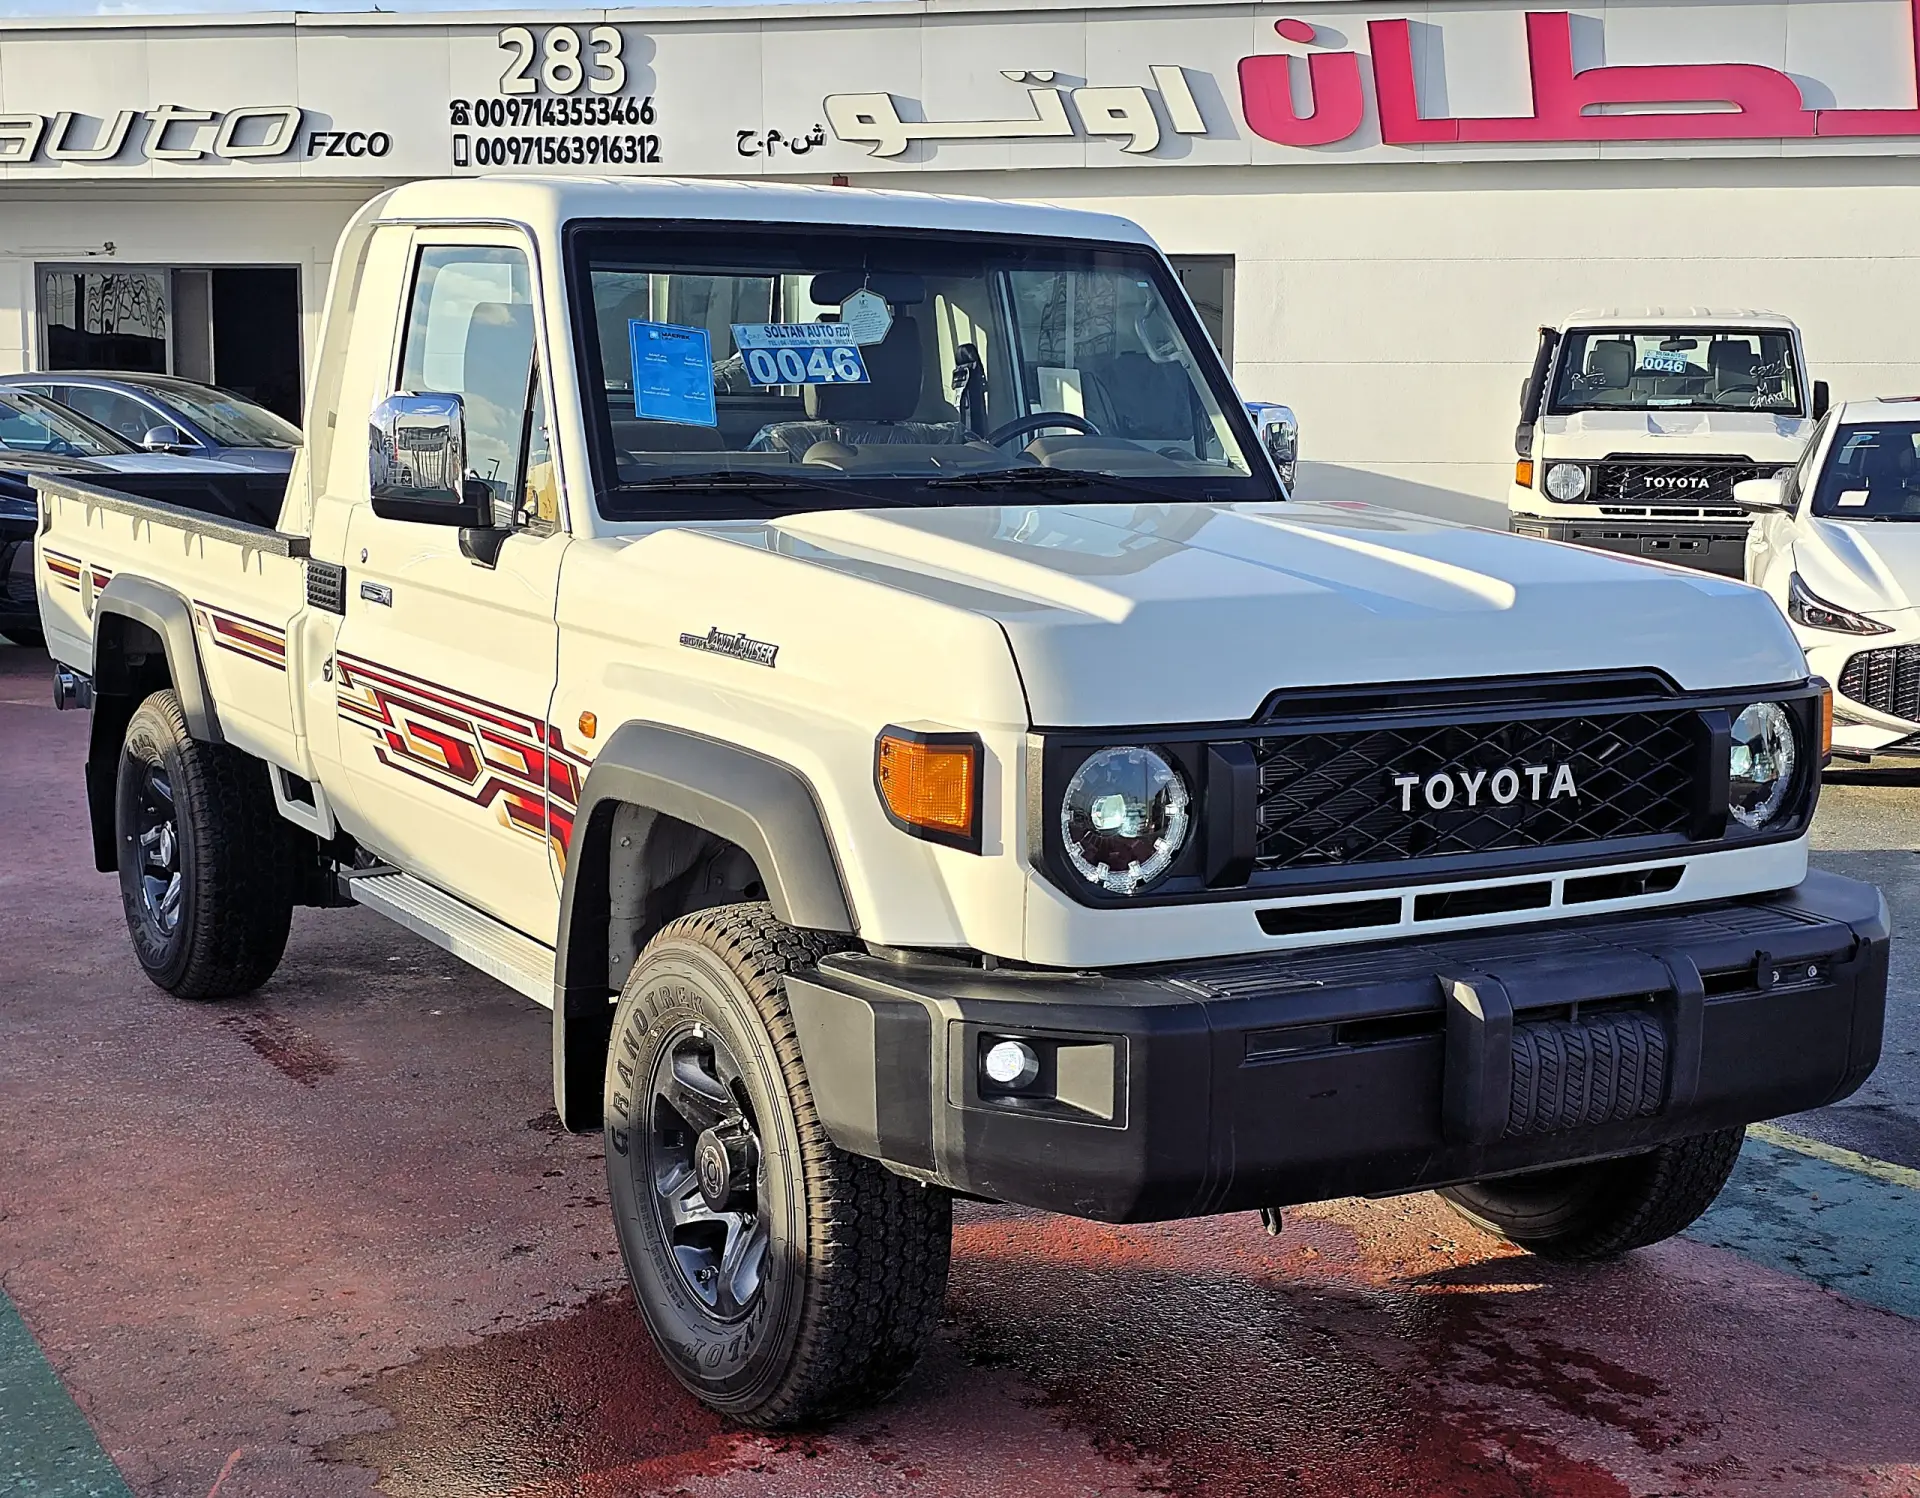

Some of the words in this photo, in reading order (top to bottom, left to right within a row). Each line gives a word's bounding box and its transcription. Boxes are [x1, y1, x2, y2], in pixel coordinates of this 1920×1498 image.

[498, 25, 628, 95] 283
[475, 97, 655, 127] 0097143553466
[307, 131, 391, 157] FZCO
[476, 135, 661, 165] 00971563916312
[763, 325, 806, 339] SOLTAN
[807, 324, 834, 338] AUTO
[748, 347, 861, 384] 0046
[1644, 358, 1684, 373] 0046
[1643, 476, 1710, 488] TOYOTA
[1394, 764, 1578, 812] TOYOTA
